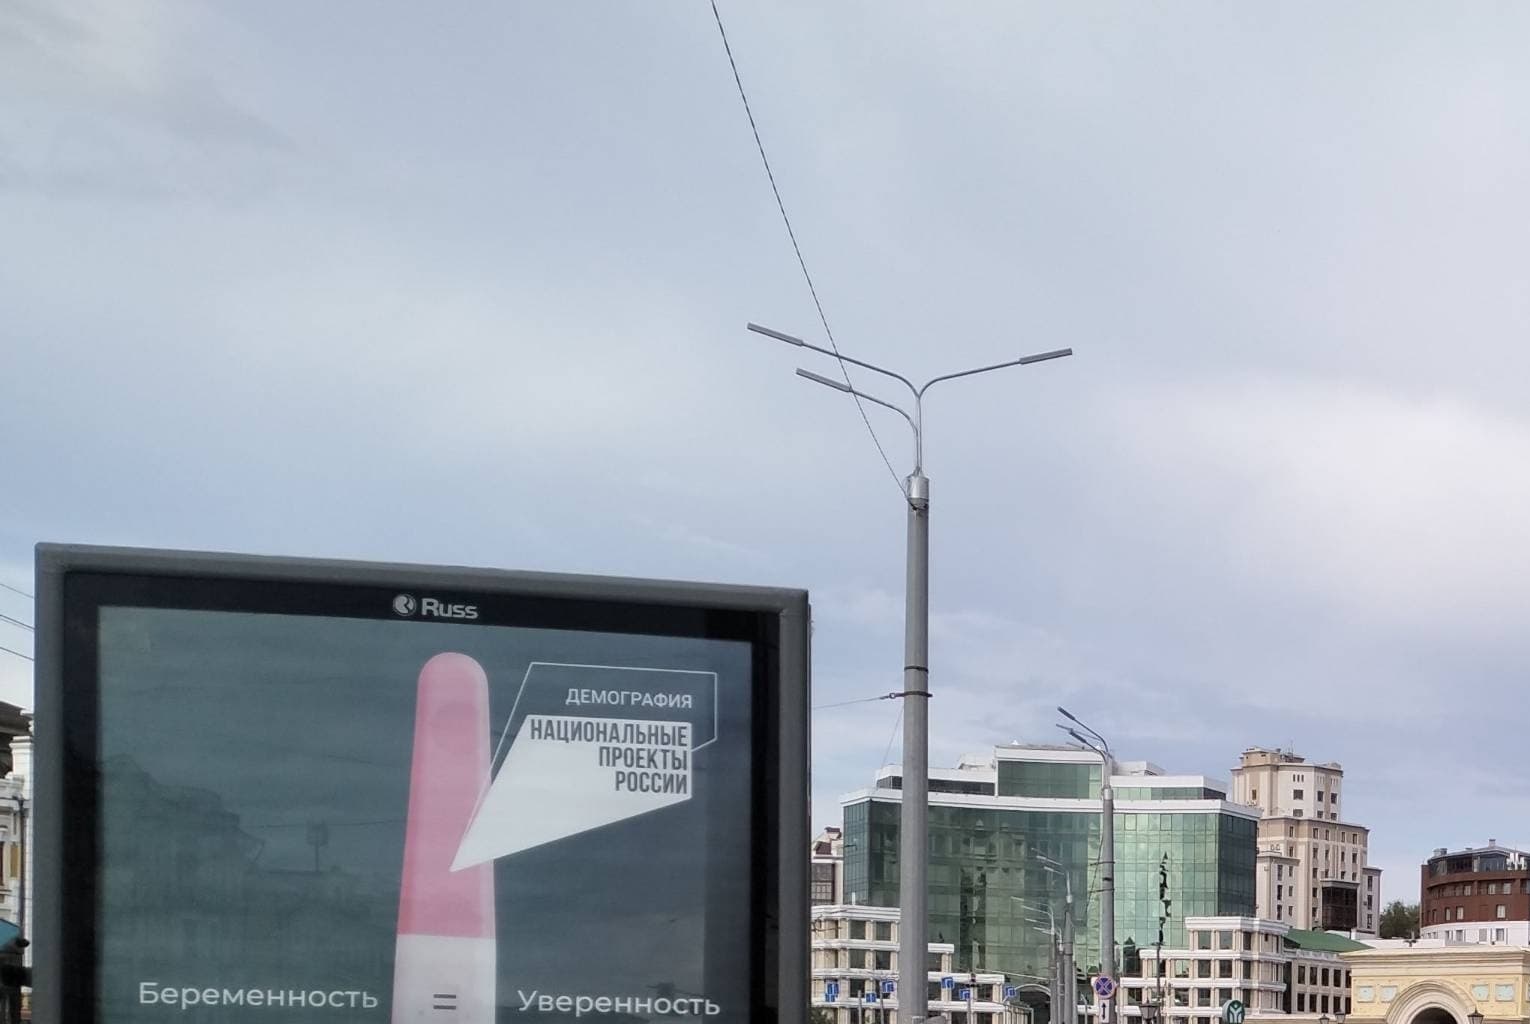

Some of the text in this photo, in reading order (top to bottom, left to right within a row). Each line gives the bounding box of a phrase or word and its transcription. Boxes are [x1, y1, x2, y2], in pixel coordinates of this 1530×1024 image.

[421, 598, 478, 619] Russ
[565, 688, 692, 709] ДЕМОГРАФИЯ
[530, 718, 688, 746] НАЦИОНАЛЬНЫЕ
[598, 746, 688, 771] ПРОЕКТЫ
[615, 771, 688, 795] РОССИИ
[139, 982, 378, 1009] Беременность
[517, 990, 721, 1017] Уверенность
